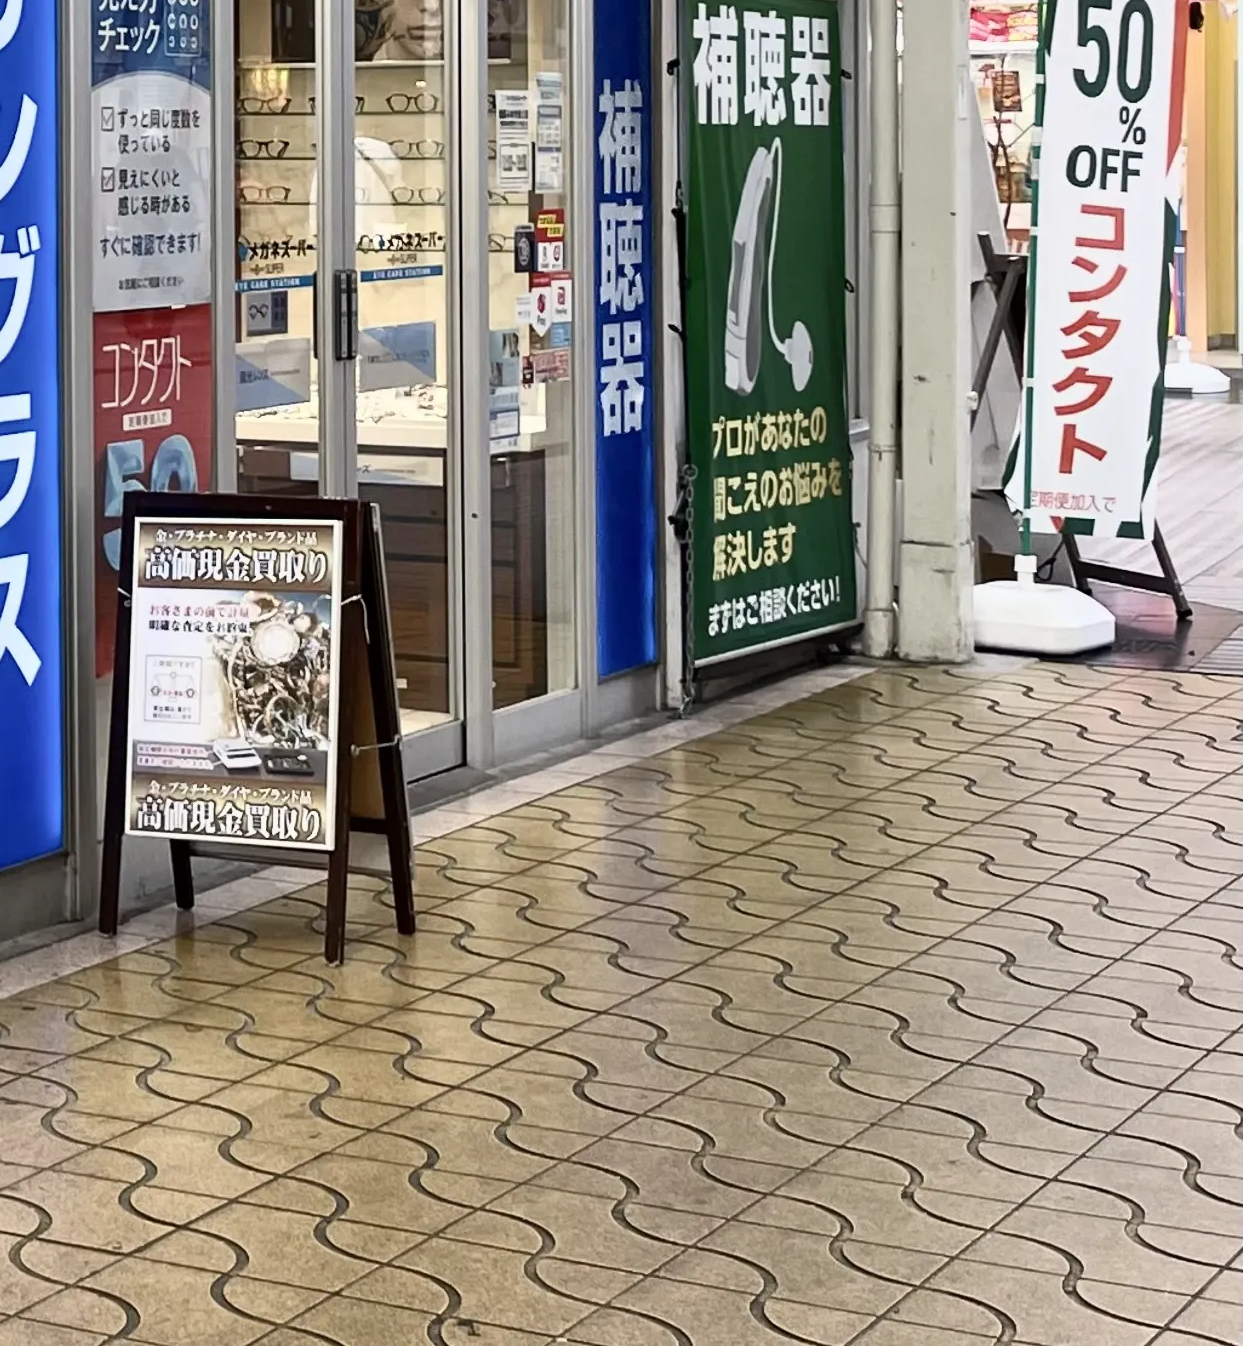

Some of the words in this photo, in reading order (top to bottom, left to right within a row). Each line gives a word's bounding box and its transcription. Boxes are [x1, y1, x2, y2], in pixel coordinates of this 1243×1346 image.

[97, 16, 161, 55] チェック
[692, 2, 831, 127] 補聴器
[117, 107, 201, 130] ずっと同じ度数を
[1118, 105, 1147, 146] %
[117, 133, 171, 155] 使っている
[117, 167, 181, 190] 見えにくいと
[1065, 145, 1144, 195] OFF
[117, 194, 191, 217] 感じる時がある
[249, 238, 315, 261] メガネスーパー
[387, 230, 445, 251] メガネスーパー
[599, 79, 646, 438] 補聴器
[1050, 202, 1126, 474] コンタクト
[100, 334, 193, 409] コンタクト
[711, 405, 828, 460] プロがあなたの
[144, 545, 329, 585] 高価現金買取り
[712, 522, 798, 582] 解決します
[137, 795, 323, 841] 高価現金買取り
